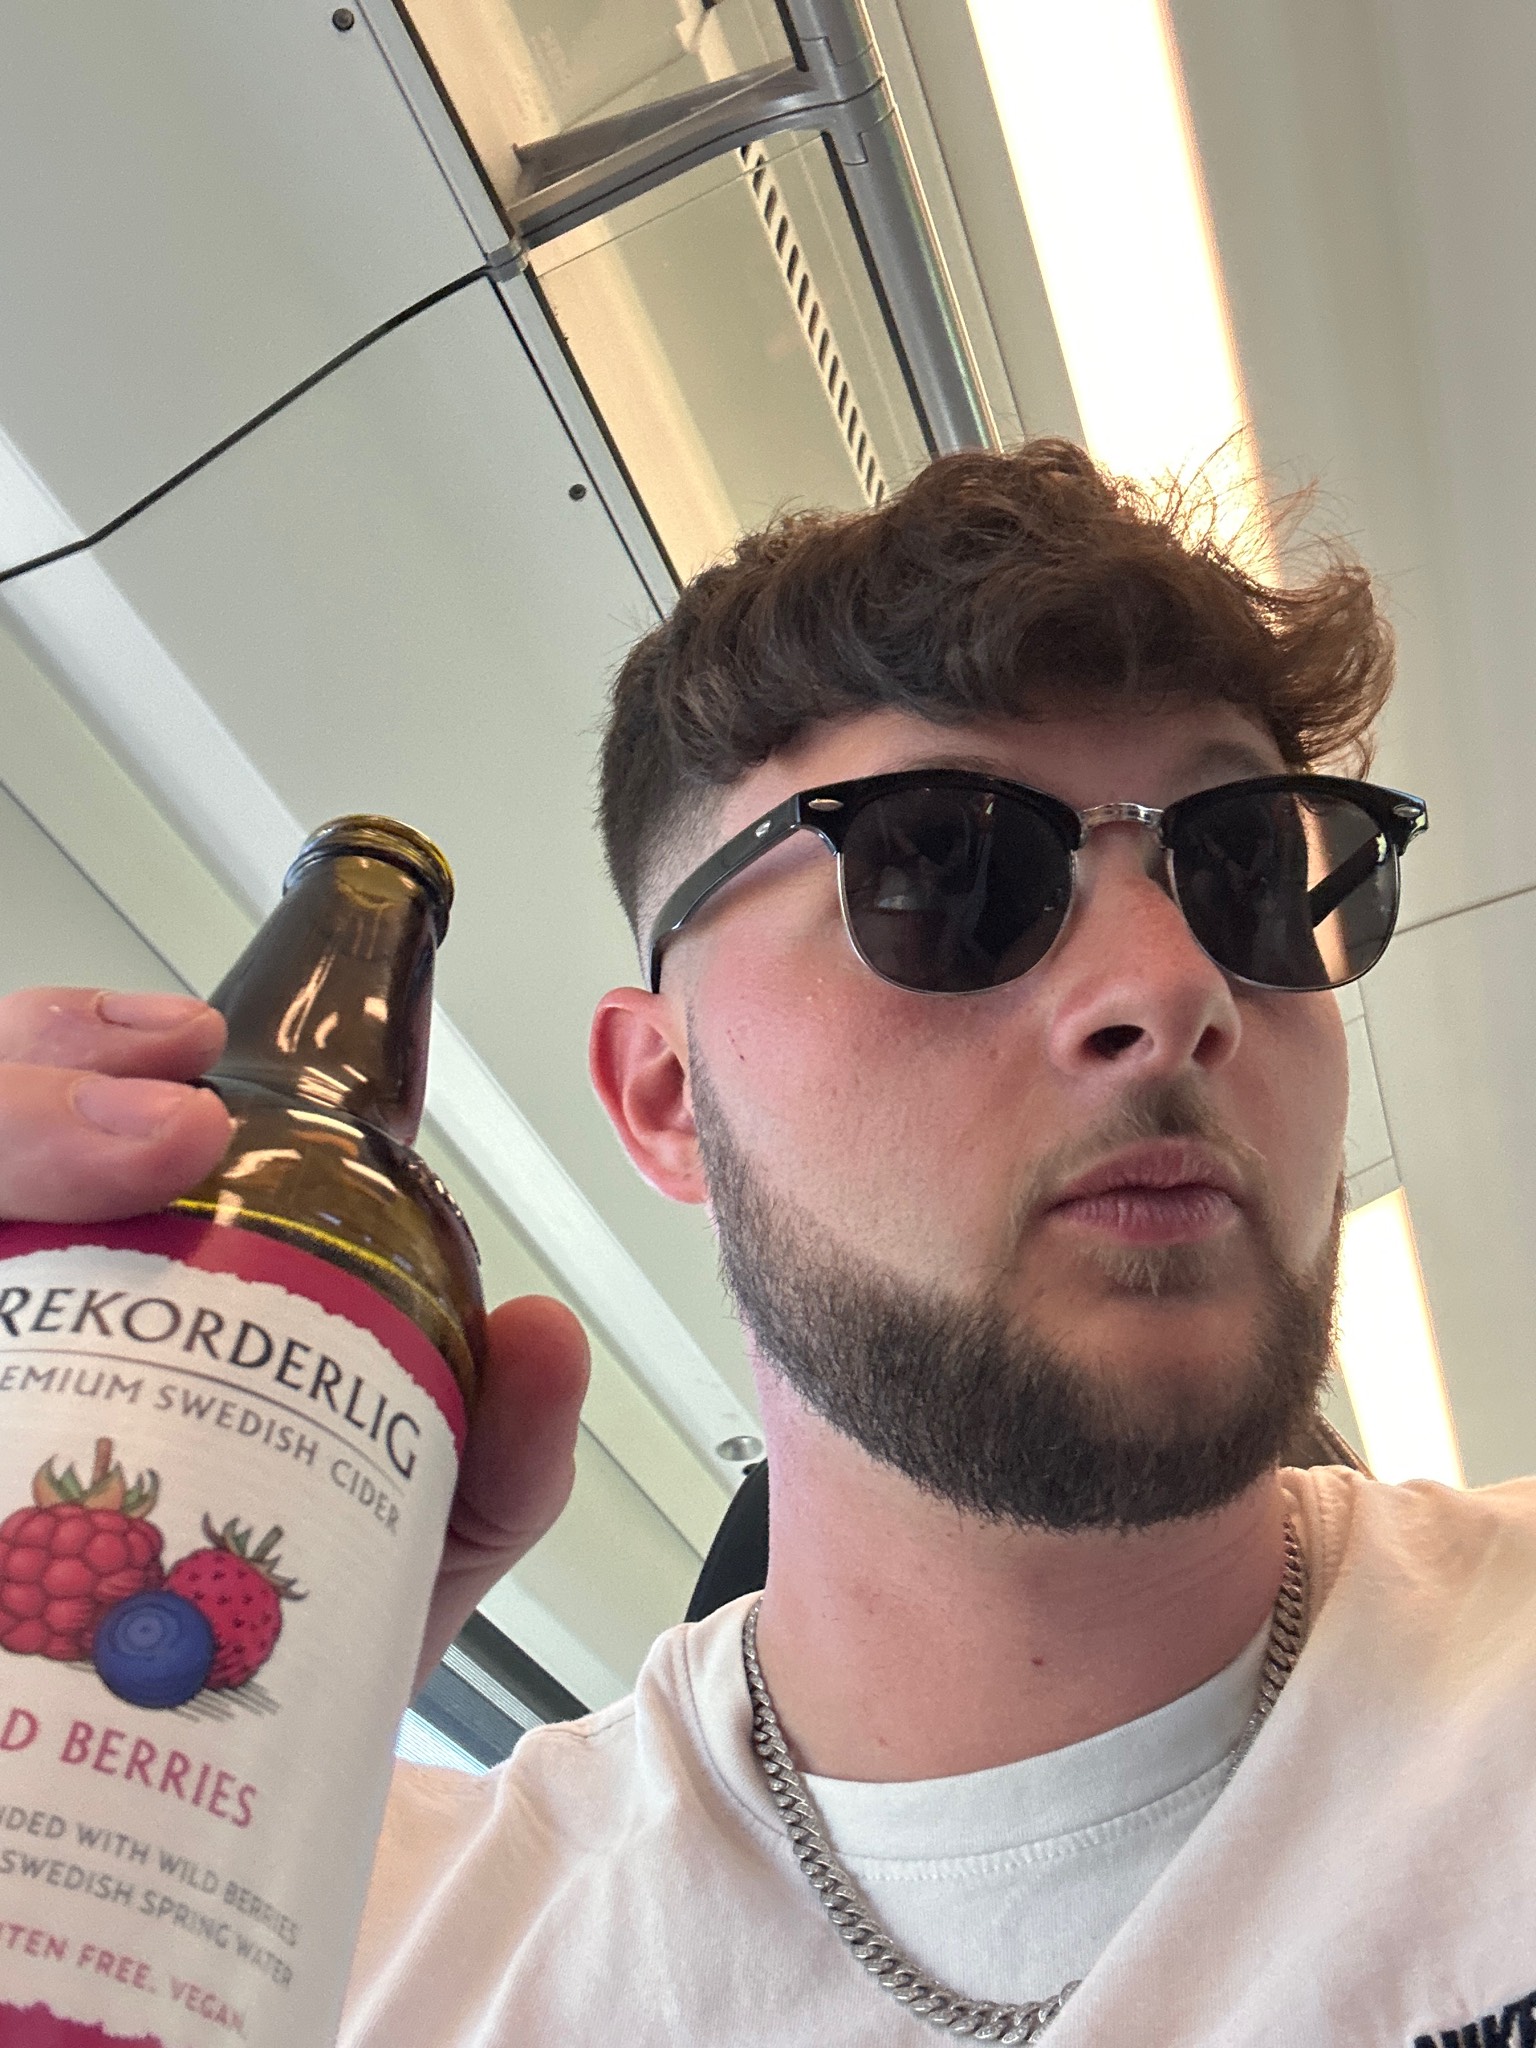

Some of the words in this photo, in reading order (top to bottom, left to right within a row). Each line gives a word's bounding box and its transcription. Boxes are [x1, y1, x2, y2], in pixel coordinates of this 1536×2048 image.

[0, 1286, 421, 1480] REKORDERLIG
[154, 1384, 319, 1466] SWEDISH
[330, 1458, 400, 1535] CIDER
[60, 1720, 257, 1829] BERRIES
[0, 1849, 133, 1905] SWEDISH
[139, 1890, 231, 1949] SPRING
[236, 1933, 294, 1987] WATER
[0, 1921, 69, 1961] TEN
[76, 1822, 150, 1865] WITH
[158, 1849, 219, 1895] WILD
[224, 1880, 298, 1947] BERRIES
